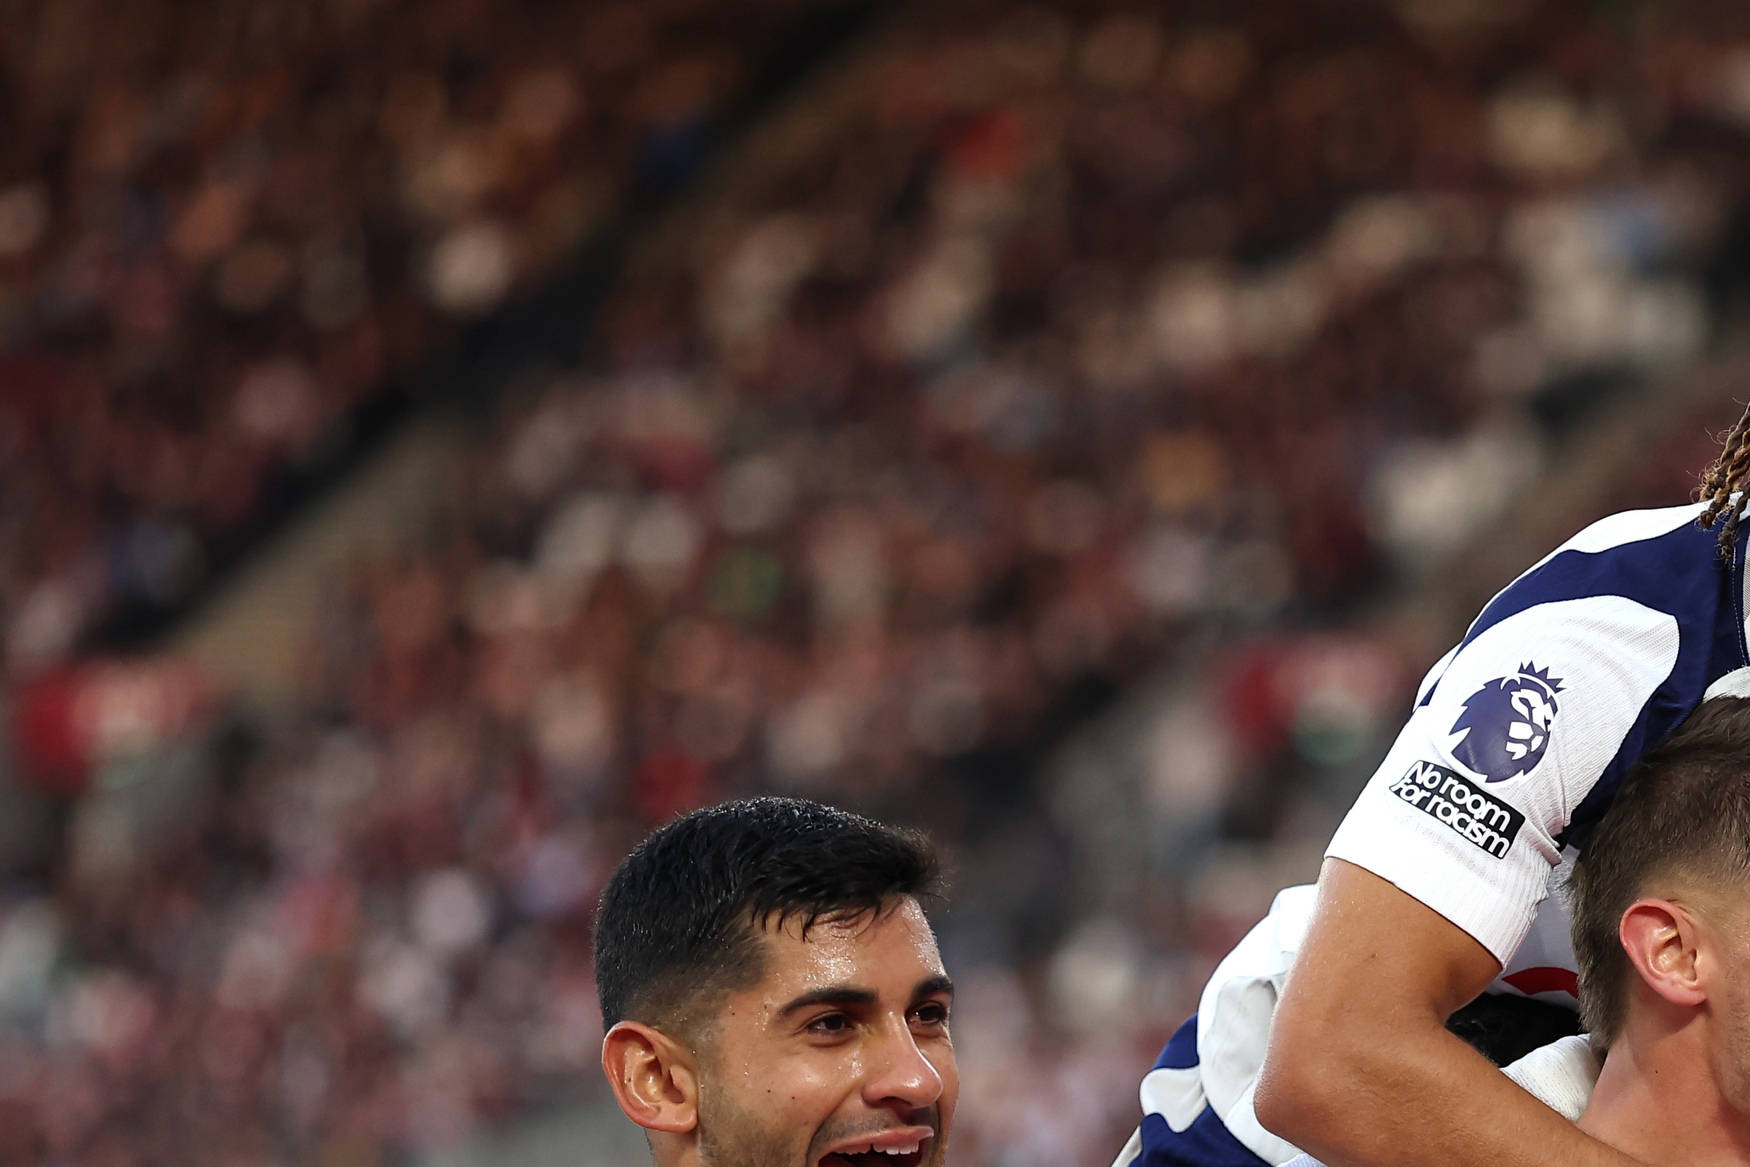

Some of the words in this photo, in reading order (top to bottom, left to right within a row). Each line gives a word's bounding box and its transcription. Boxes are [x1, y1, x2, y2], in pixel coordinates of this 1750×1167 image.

[1391, 777, 1431, 805] for
[1424, 795, 1510, 858] racism
[1404, 760, 1441, 789] No
[1439, 776, 1511, 832] room
